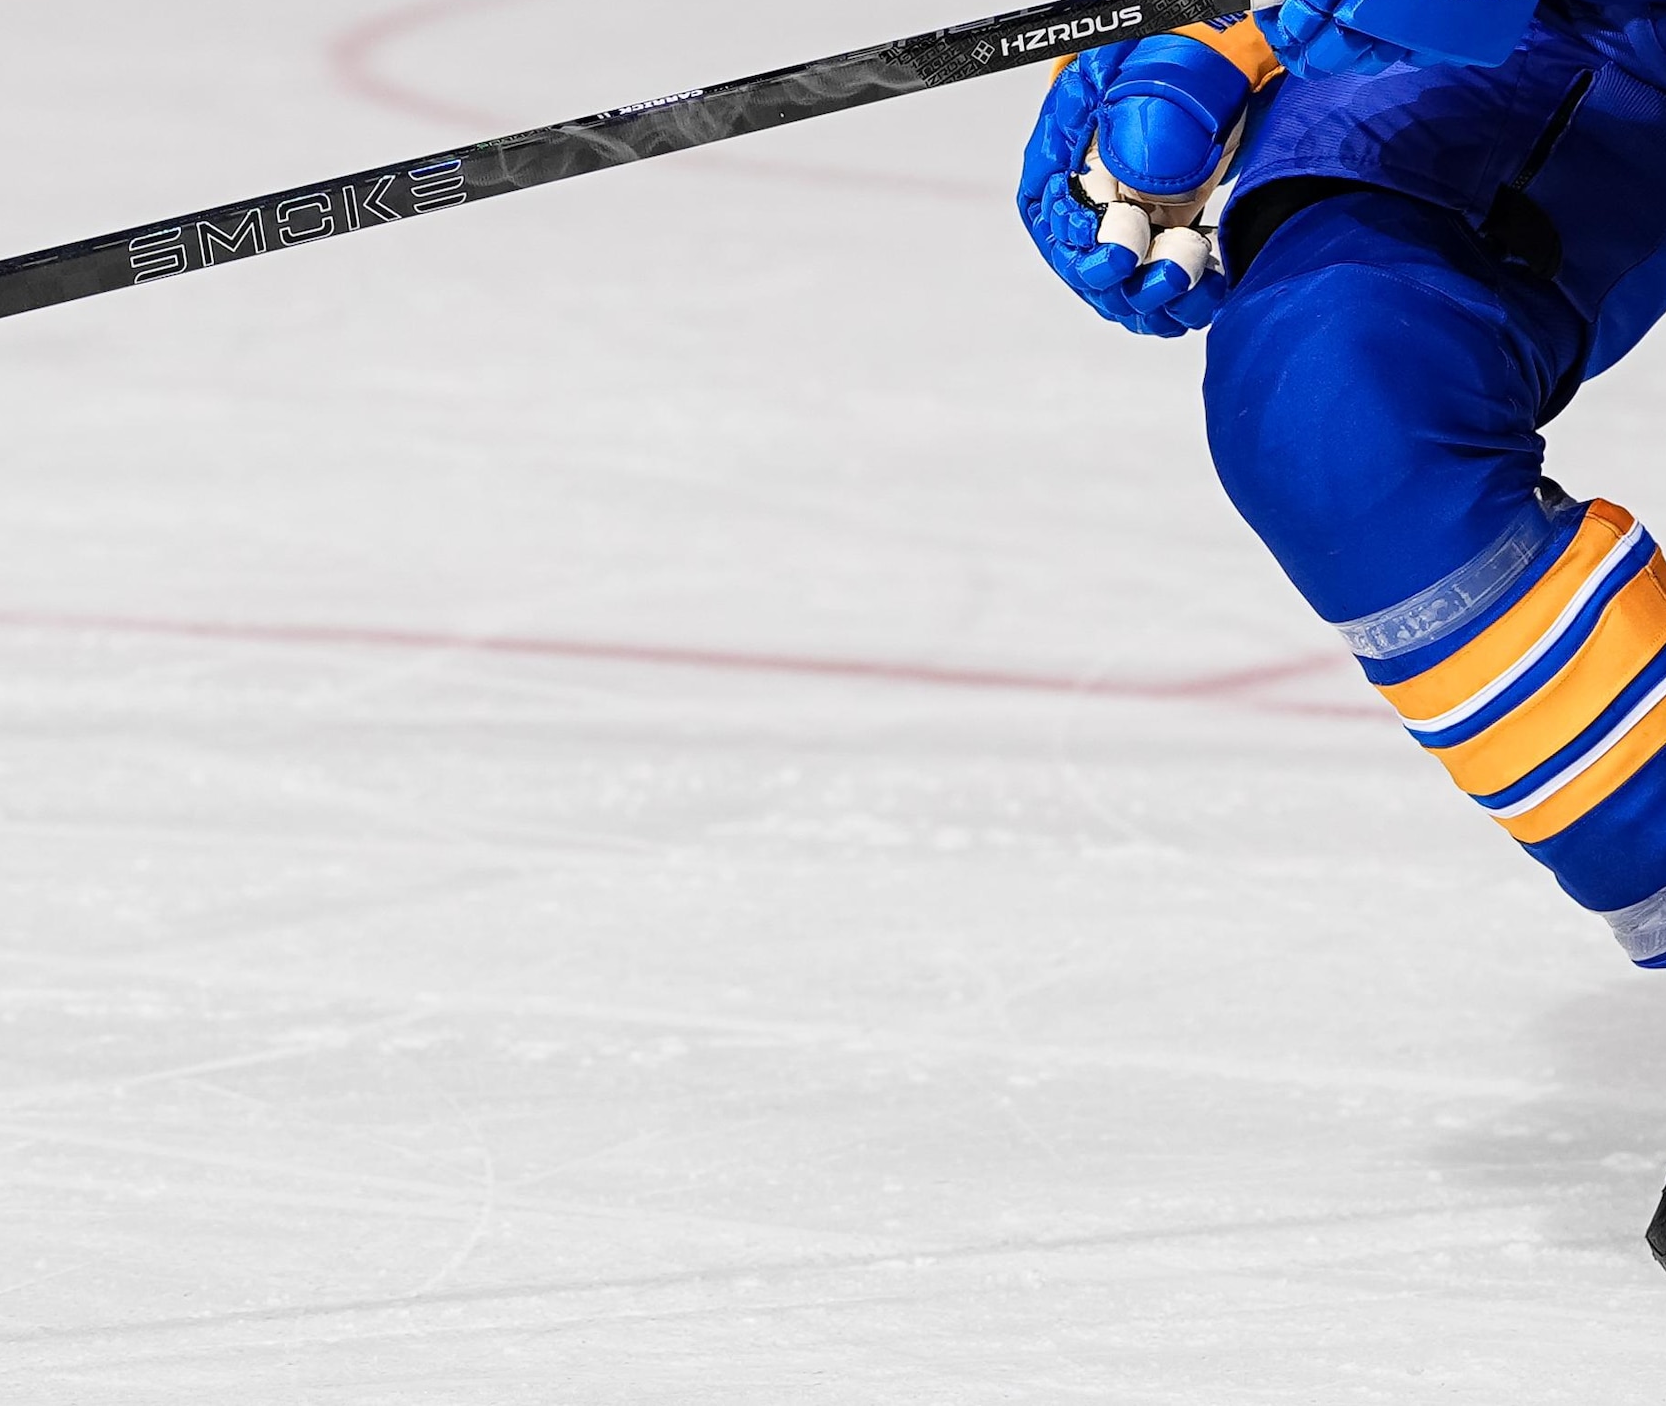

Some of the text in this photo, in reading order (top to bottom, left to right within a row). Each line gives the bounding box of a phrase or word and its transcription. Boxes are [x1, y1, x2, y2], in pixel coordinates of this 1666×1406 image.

[999, 4, 1144, 58] HZRDUS
[619, 88, 704, 116] CARRICK
[128, 157, 467, 284] SMOKE
